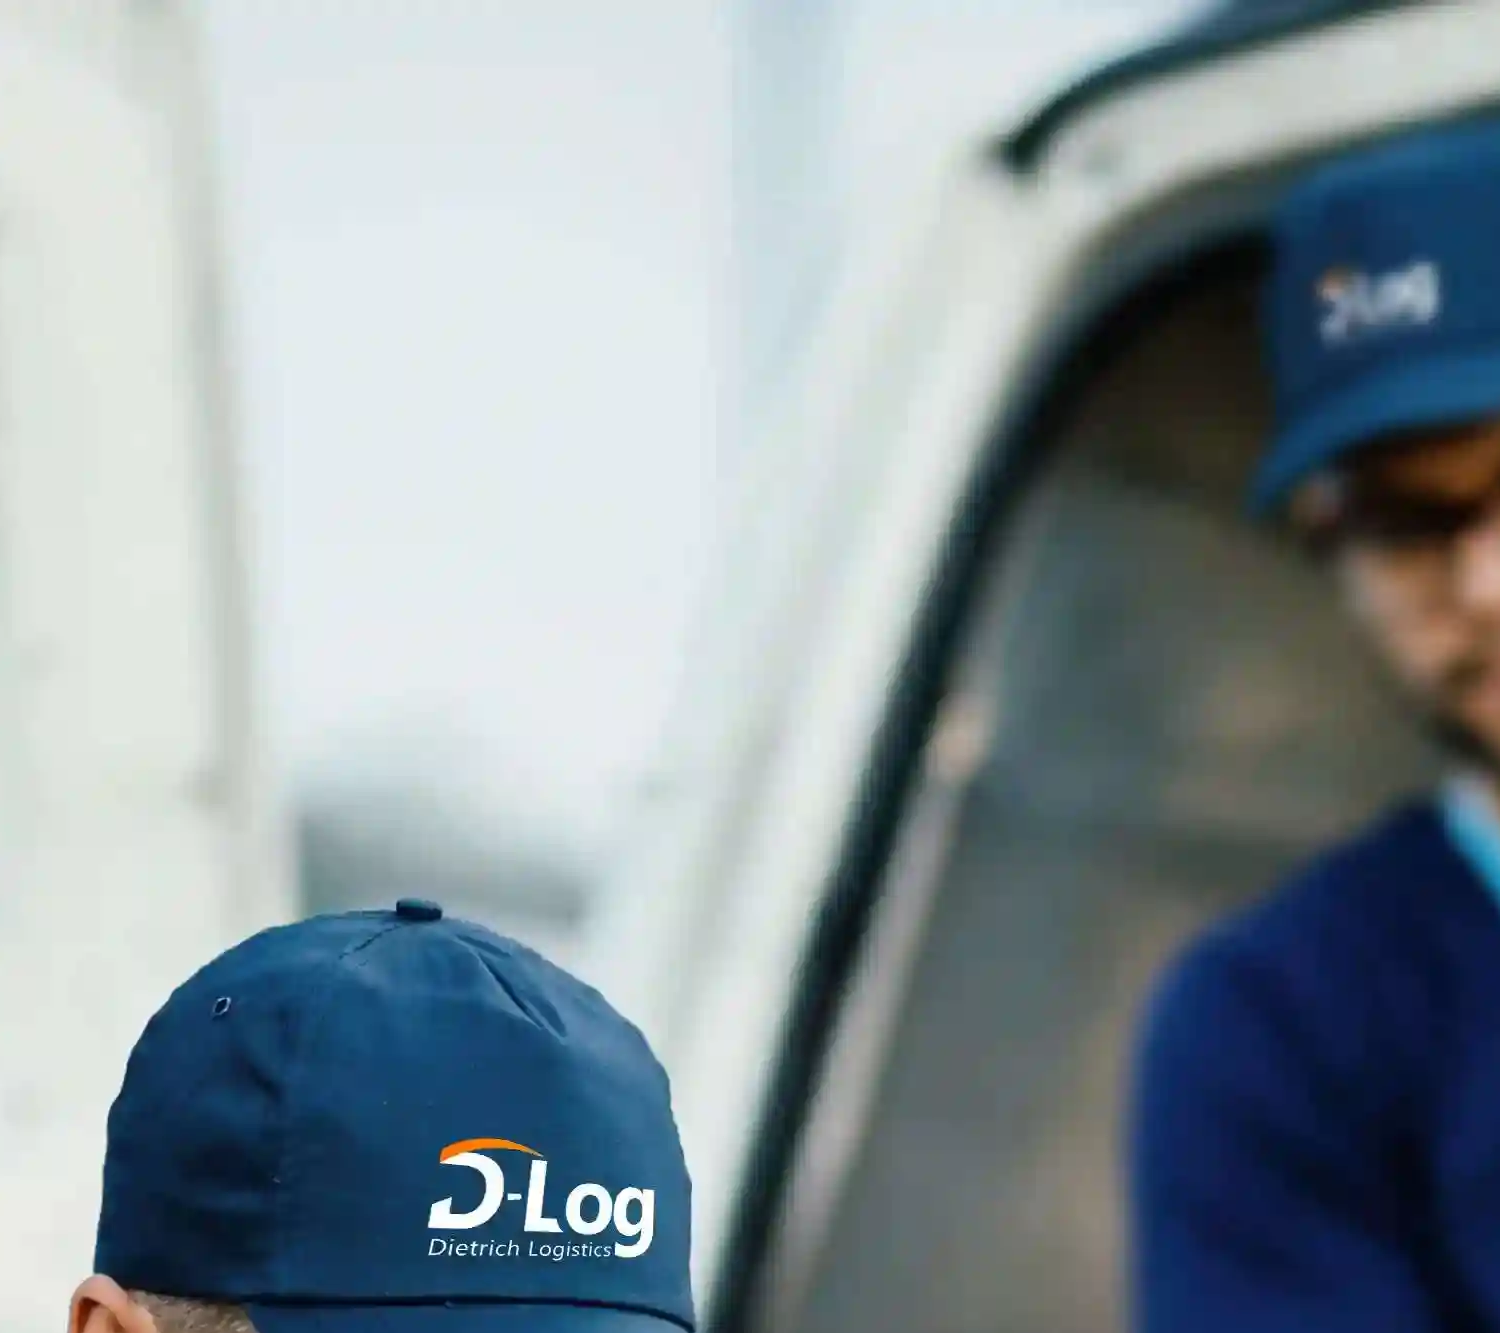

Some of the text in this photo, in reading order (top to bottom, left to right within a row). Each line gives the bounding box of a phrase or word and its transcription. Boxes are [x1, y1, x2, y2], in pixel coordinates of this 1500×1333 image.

[427, 1138, 655, 1258] D-Log
[428, 1238, 612, 1261] Dietrich Logistics
